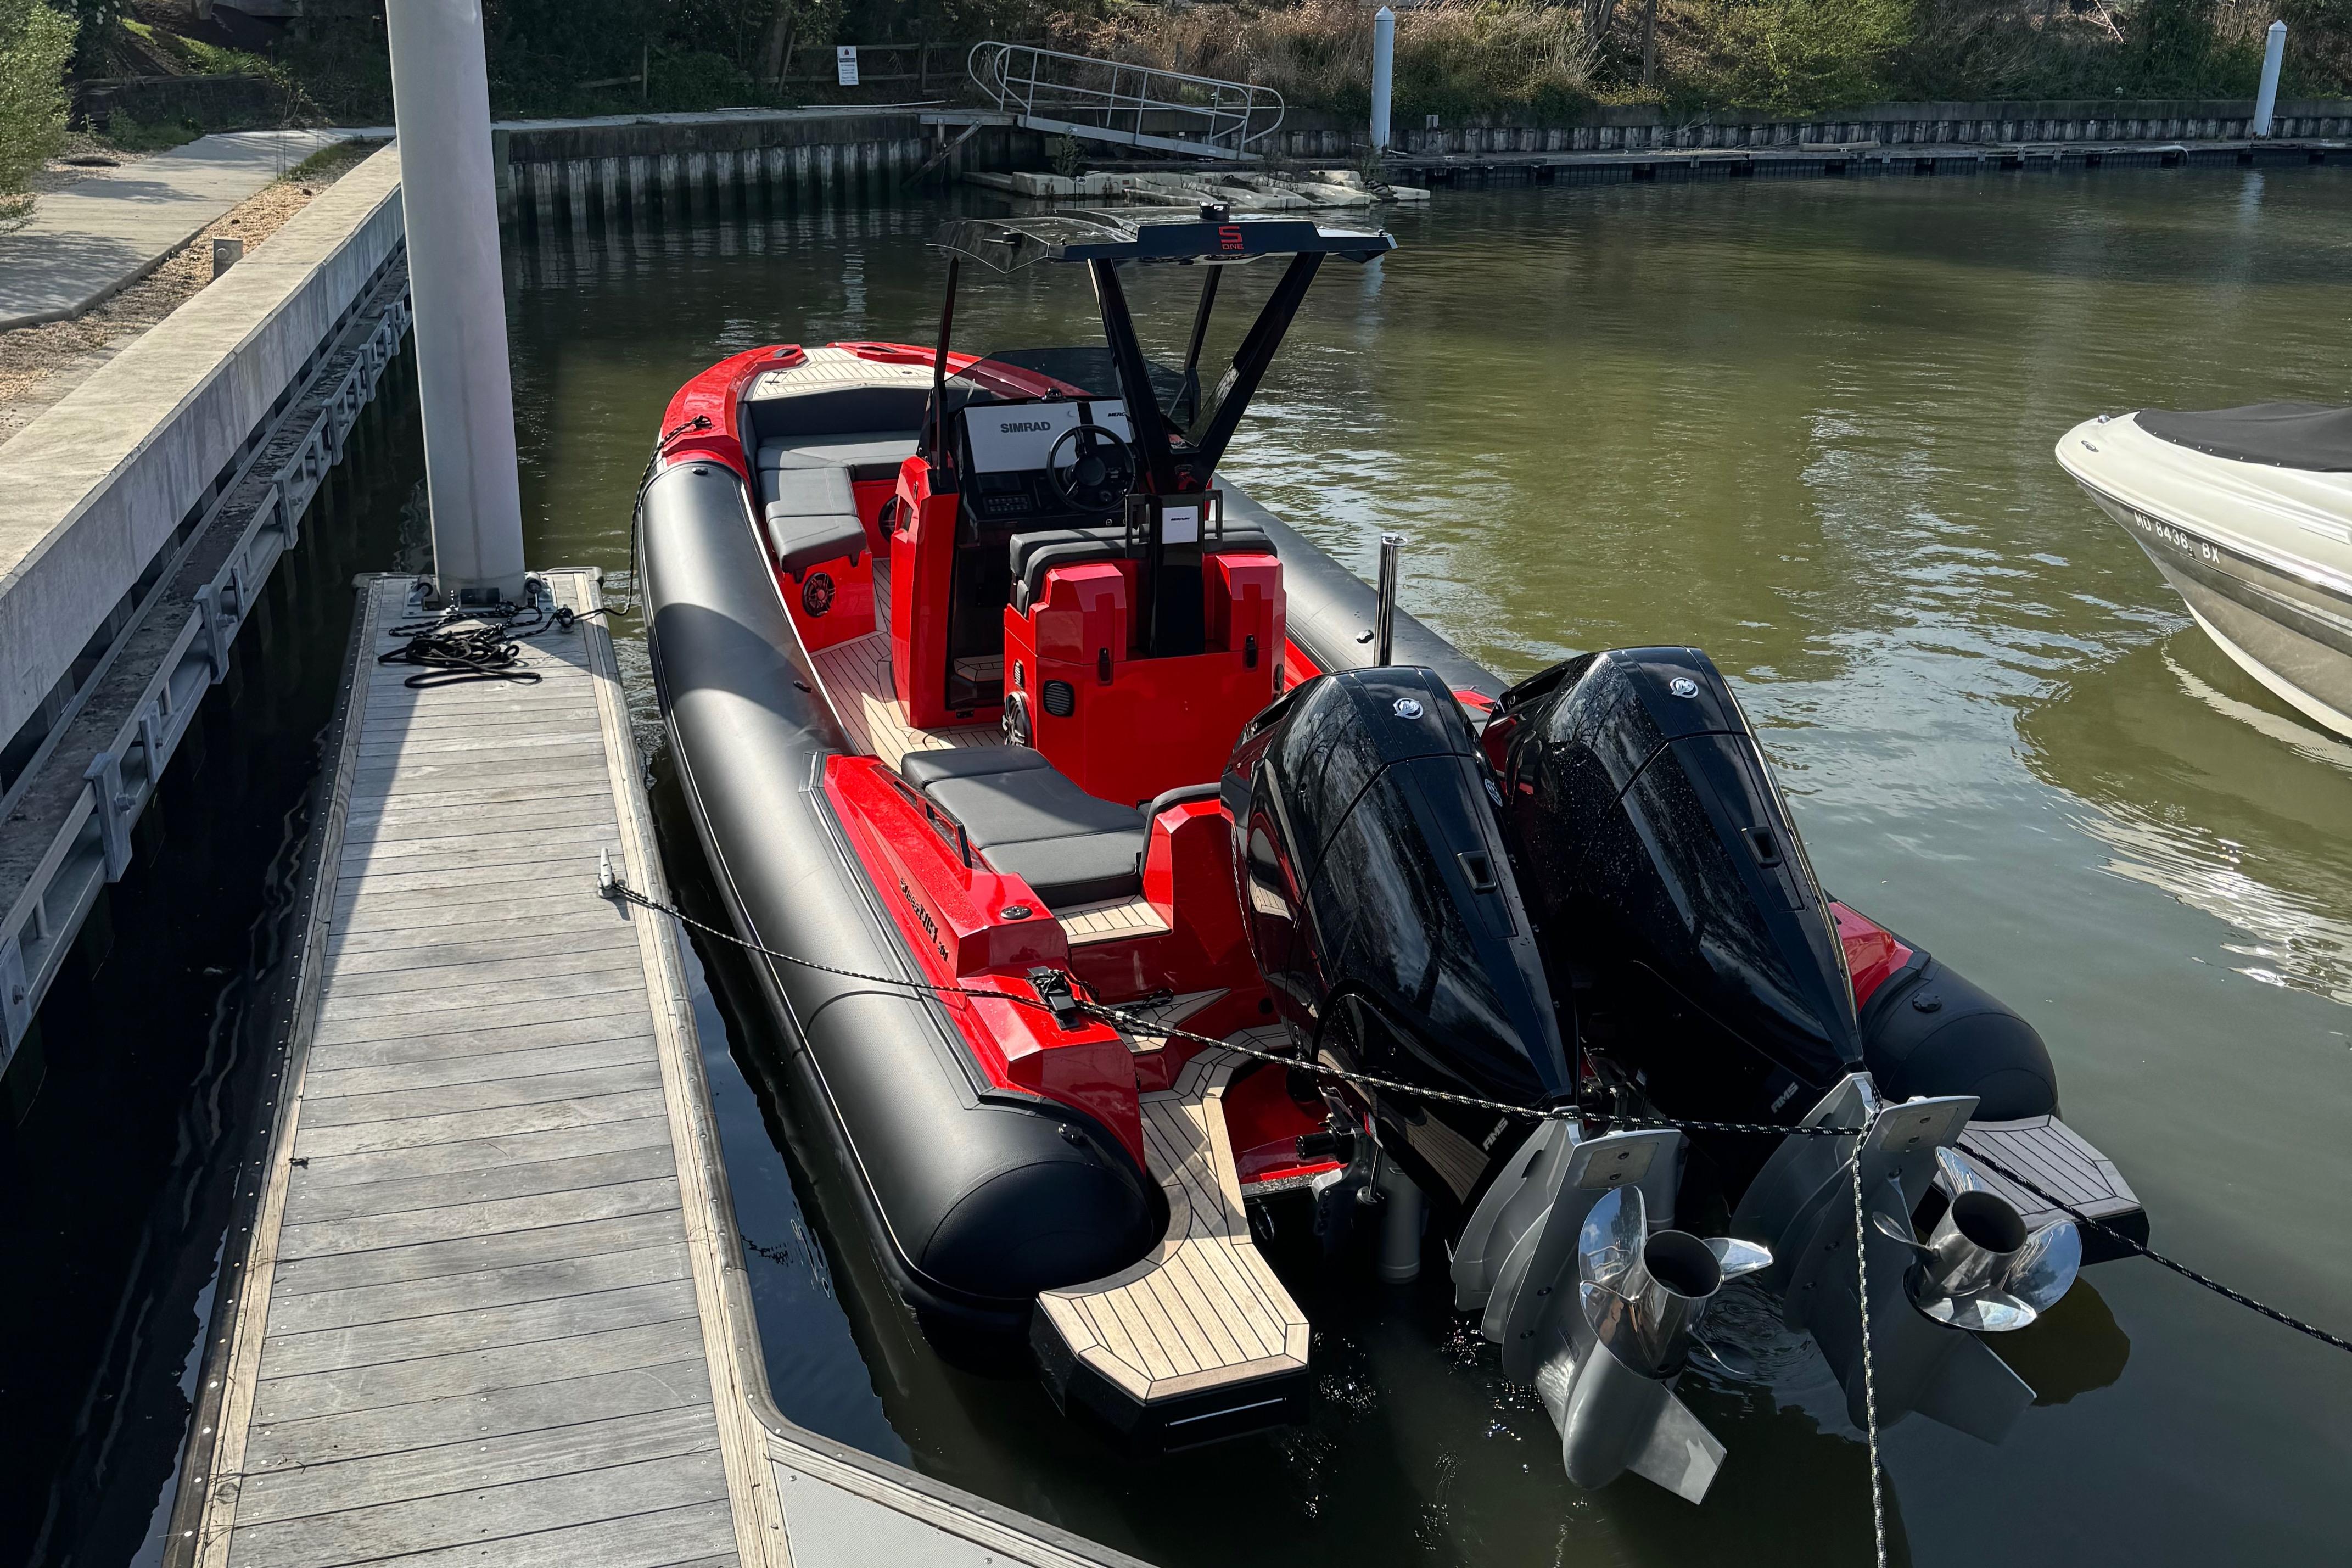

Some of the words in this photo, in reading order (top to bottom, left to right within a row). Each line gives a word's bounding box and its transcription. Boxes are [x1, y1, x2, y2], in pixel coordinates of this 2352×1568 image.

[1000, 421, 1051, 433] SIMRAD
[2155, 522, 2188, 550] 8436
[2202, 543, 2220, 564] BX
[1483, 1117, 1509, 1151] AMS
